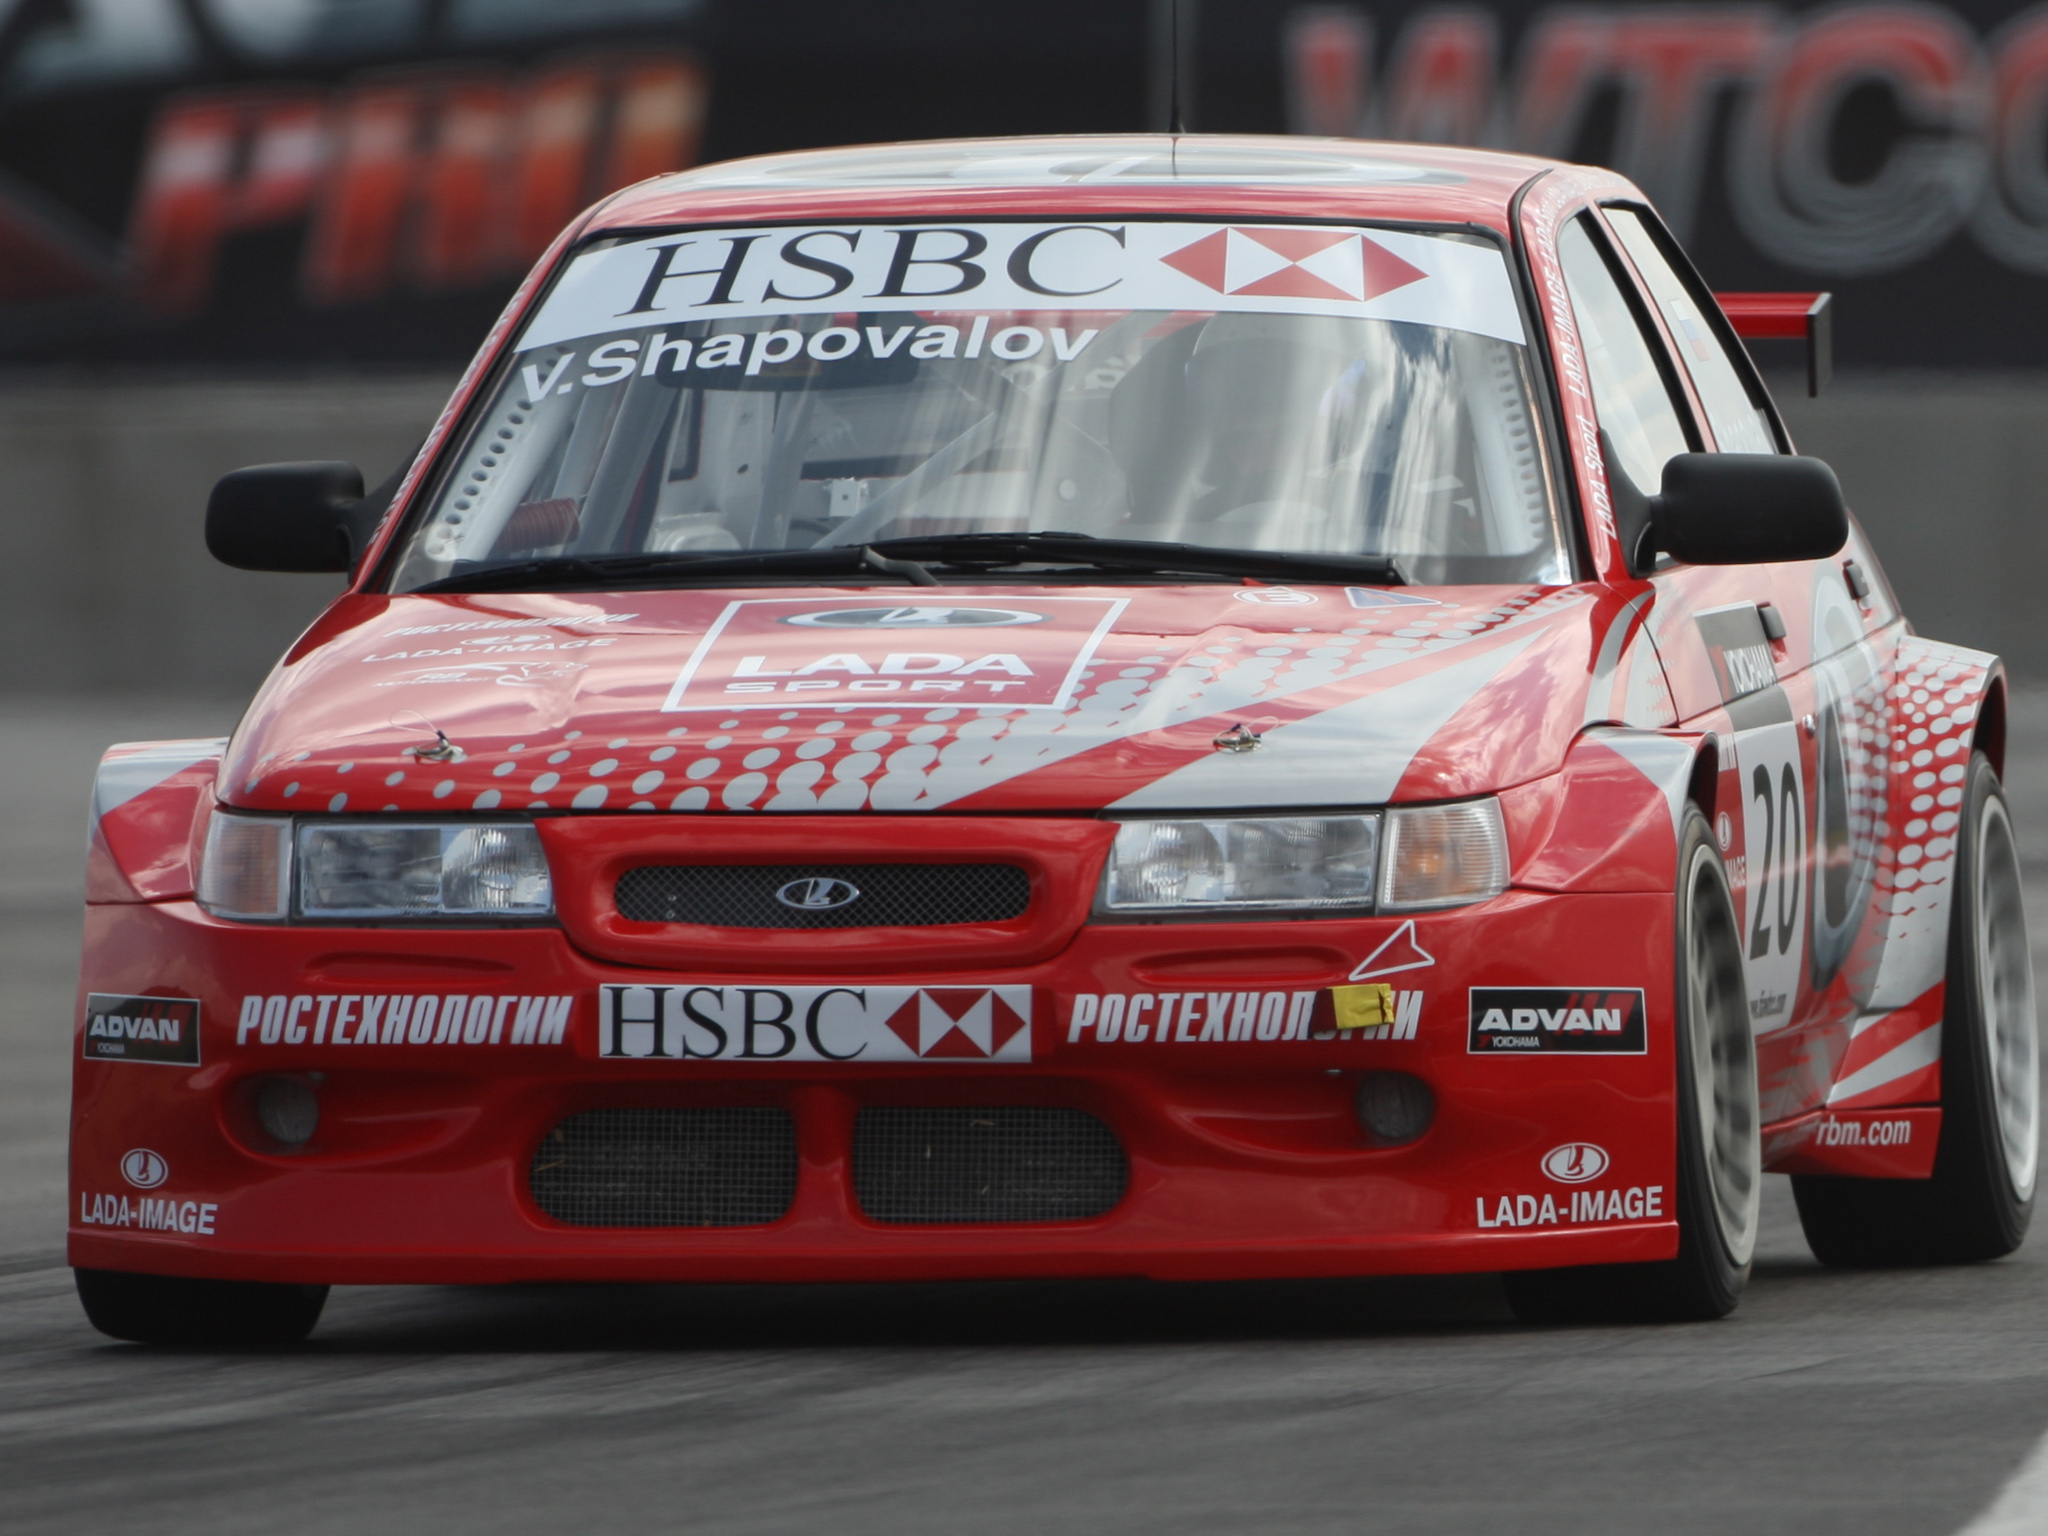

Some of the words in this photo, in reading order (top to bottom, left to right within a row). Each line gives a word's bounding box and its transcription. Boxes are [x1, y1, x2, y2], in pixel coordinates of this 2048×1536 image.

[1284, 4, 2048, 277] WTC
[613, 225, 1126, 317] HSBC
[1544, 266, 1587, 399] LADA-IMAGE
[520, 315, 1099, 402] V.Shapovalov
[1575, 414, 1604, 476] Sport
[1590, 479, 1618, 540] LADA
[362, 638, 618, 662] LADA-IMAGE
[732, 653, 1034, 677] LADA
[724, 680, 1026, 693] SPORT
[1749, 762, 1800, 961] 20
[89, 1014, 179, 1042] ADVAN
[237, 995, 573, 1045] РОСТЕХНОЛОГИИ
[603, 986, 868, 1060] HSBC
[1477, 1008, 1622, 1031] ADVAN
[1492, 1036, 1540, 1048] YOKOHAMA
[1816, 1113, 1911, 1146] rbm.com
[81, 1191, 218, 1235] LADA-IMAGE
[1476, 1186, 1663, 1228] LADA-IMAGE
